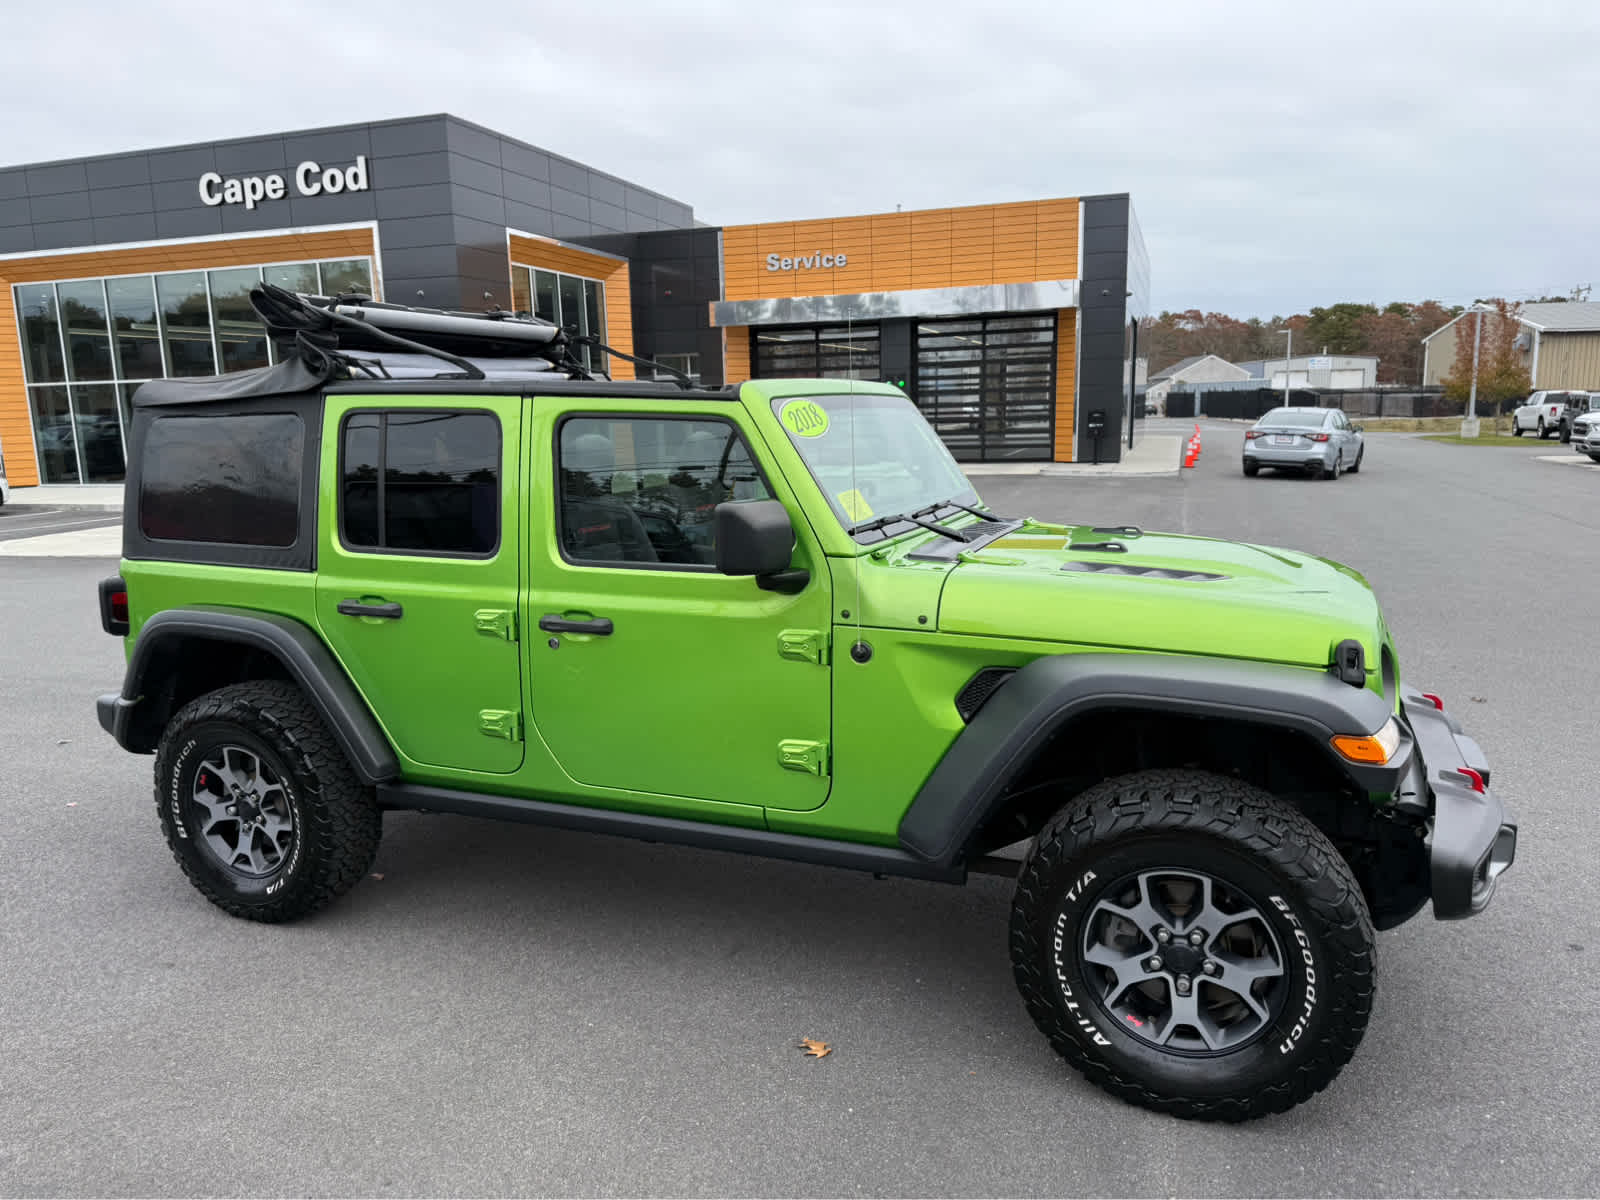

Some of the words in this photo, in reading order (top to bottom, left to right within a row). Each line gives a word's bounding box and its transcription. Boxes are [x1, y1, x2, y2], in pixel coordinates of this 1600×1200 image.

[199, 172, 286, 210] Cape
[295, 155, 369, 197] Cod
[766, 250, 847, 271] Service
[787, 403, 824, 433] 2018
[171, 739, 198, 839] BFGoodrich
[1065, 871, 1098, 902] T/A
[1053, 912, 1112, 1046] All-Terrain
[1268, 895, 1318, 1055] BFGoodrich
